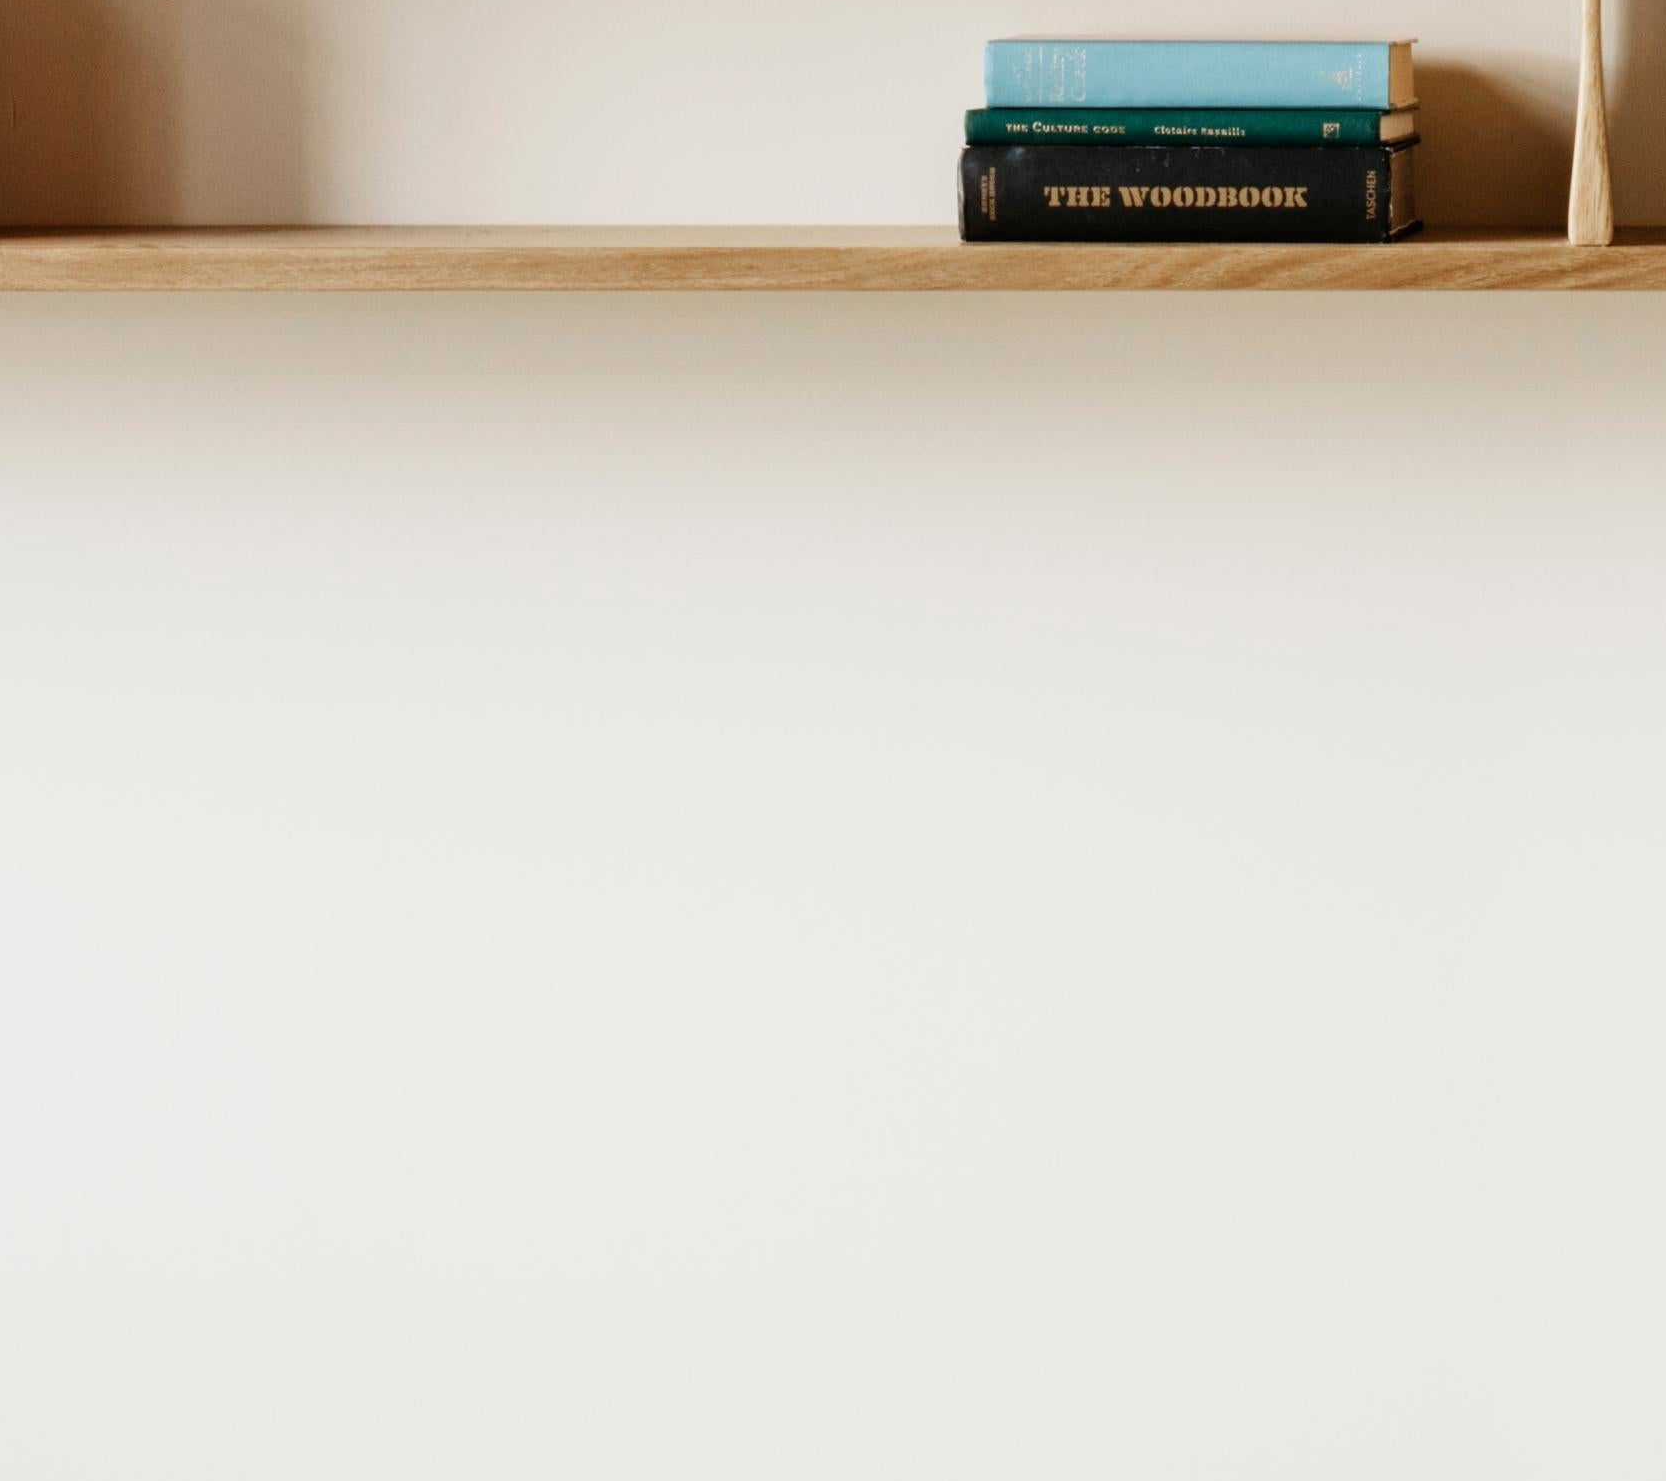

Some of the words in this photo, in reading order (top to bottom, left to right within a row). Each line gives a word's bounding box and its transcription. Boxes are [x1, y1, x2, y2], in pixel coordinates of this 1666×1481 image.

[1153, 125, 1198, 136] Clotaire
[1200, 126, 1246, 137] Rapaille
[1043, 186, 1111, 208] THE
[1118, 186, 1308, 208] WOODBOOK
[1365, 170, 1377, 220] TASCHEN
